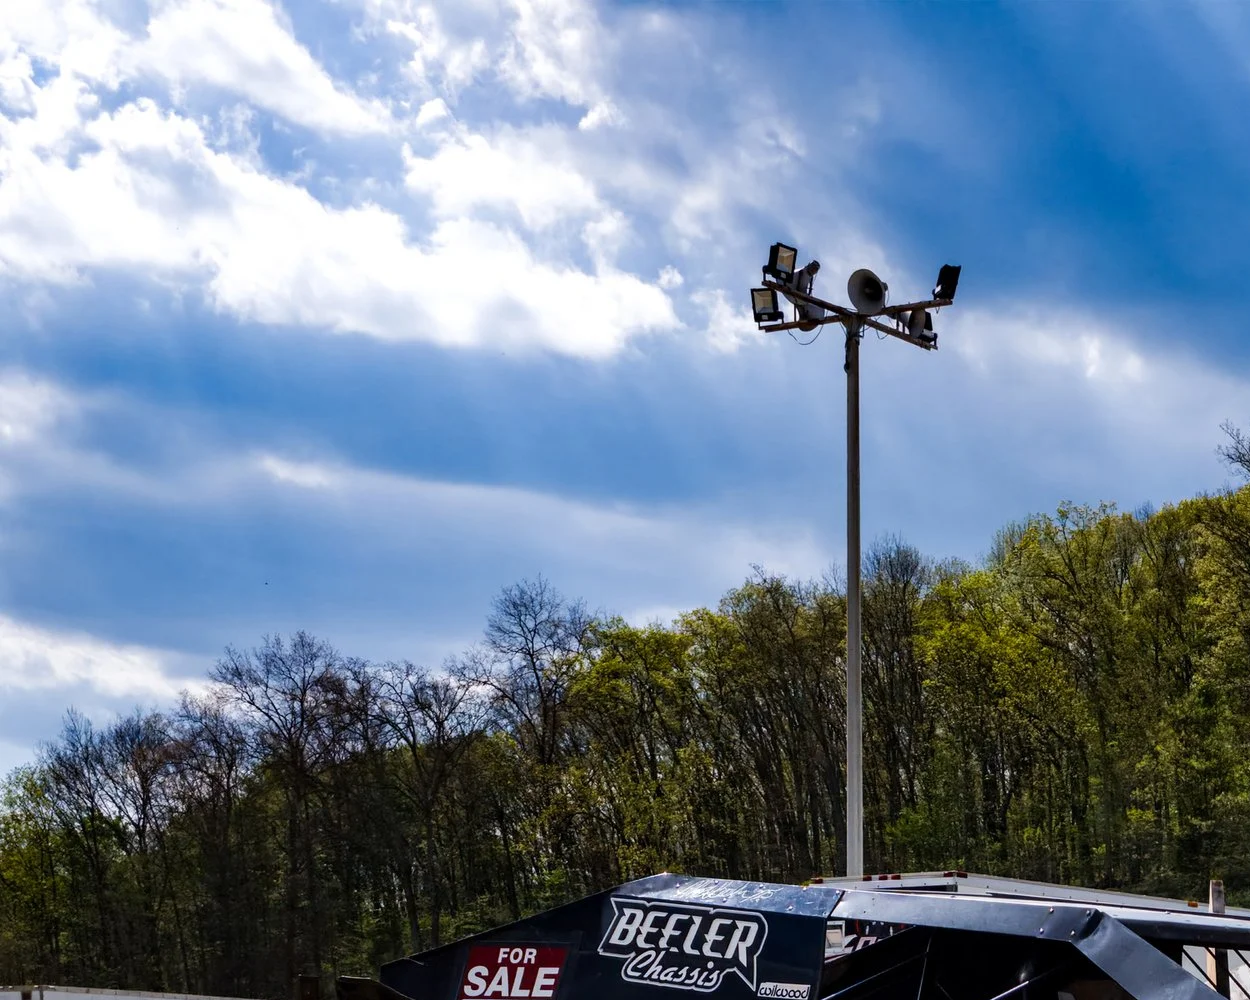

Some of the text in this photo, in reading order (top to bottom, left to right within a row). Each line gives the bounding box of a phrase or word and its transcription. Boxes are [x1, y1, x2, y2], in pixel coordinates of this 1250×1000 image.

[608, 907, 759, 967] BEELER
[497, 947, 538, 964] FOR
[626, 949, 723, 987] Chassis
[463, 965, 560, 997] SALE
[758, 984, 810, 999] wilwood
